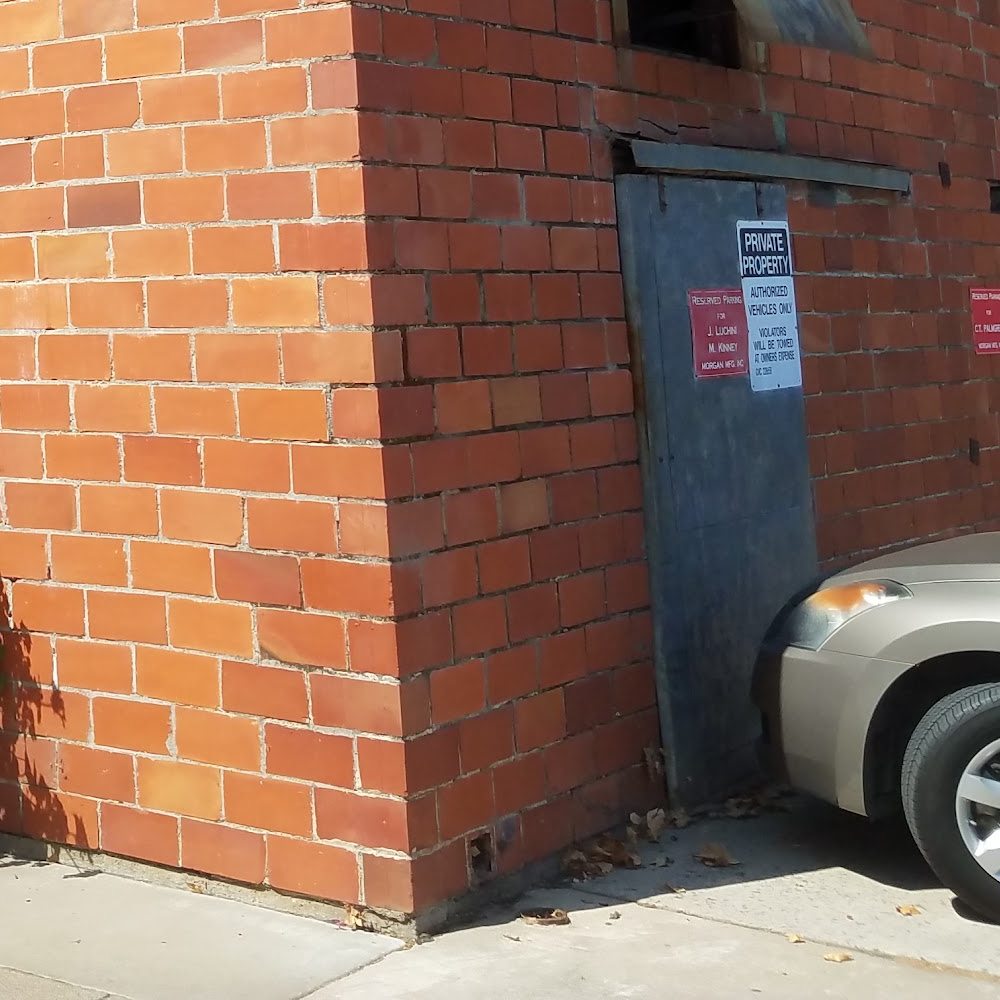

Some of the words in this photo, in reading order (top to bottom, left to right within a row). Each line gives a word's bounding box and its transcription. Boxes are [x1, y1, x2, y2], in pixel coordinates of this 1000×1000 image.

[744, 232, 785, 252] PRIVATE
[742, 255, 788, 275] PROPERTY
[750, 285, 788, 298] AUTHORIZED
[748, 303, 777, 316] VEHICLES
[779, 302, 792, 315] ONLY
[758, 326, 787, 338] VIOLATORS
[718, 342, 738, 353] KINNEY
[753, 340, 766, 350] WILL
[767, 339, 775, 350] BE
[776, 338, 794, 349] TOWED
[701, 360, 724, 370] MORGAN
